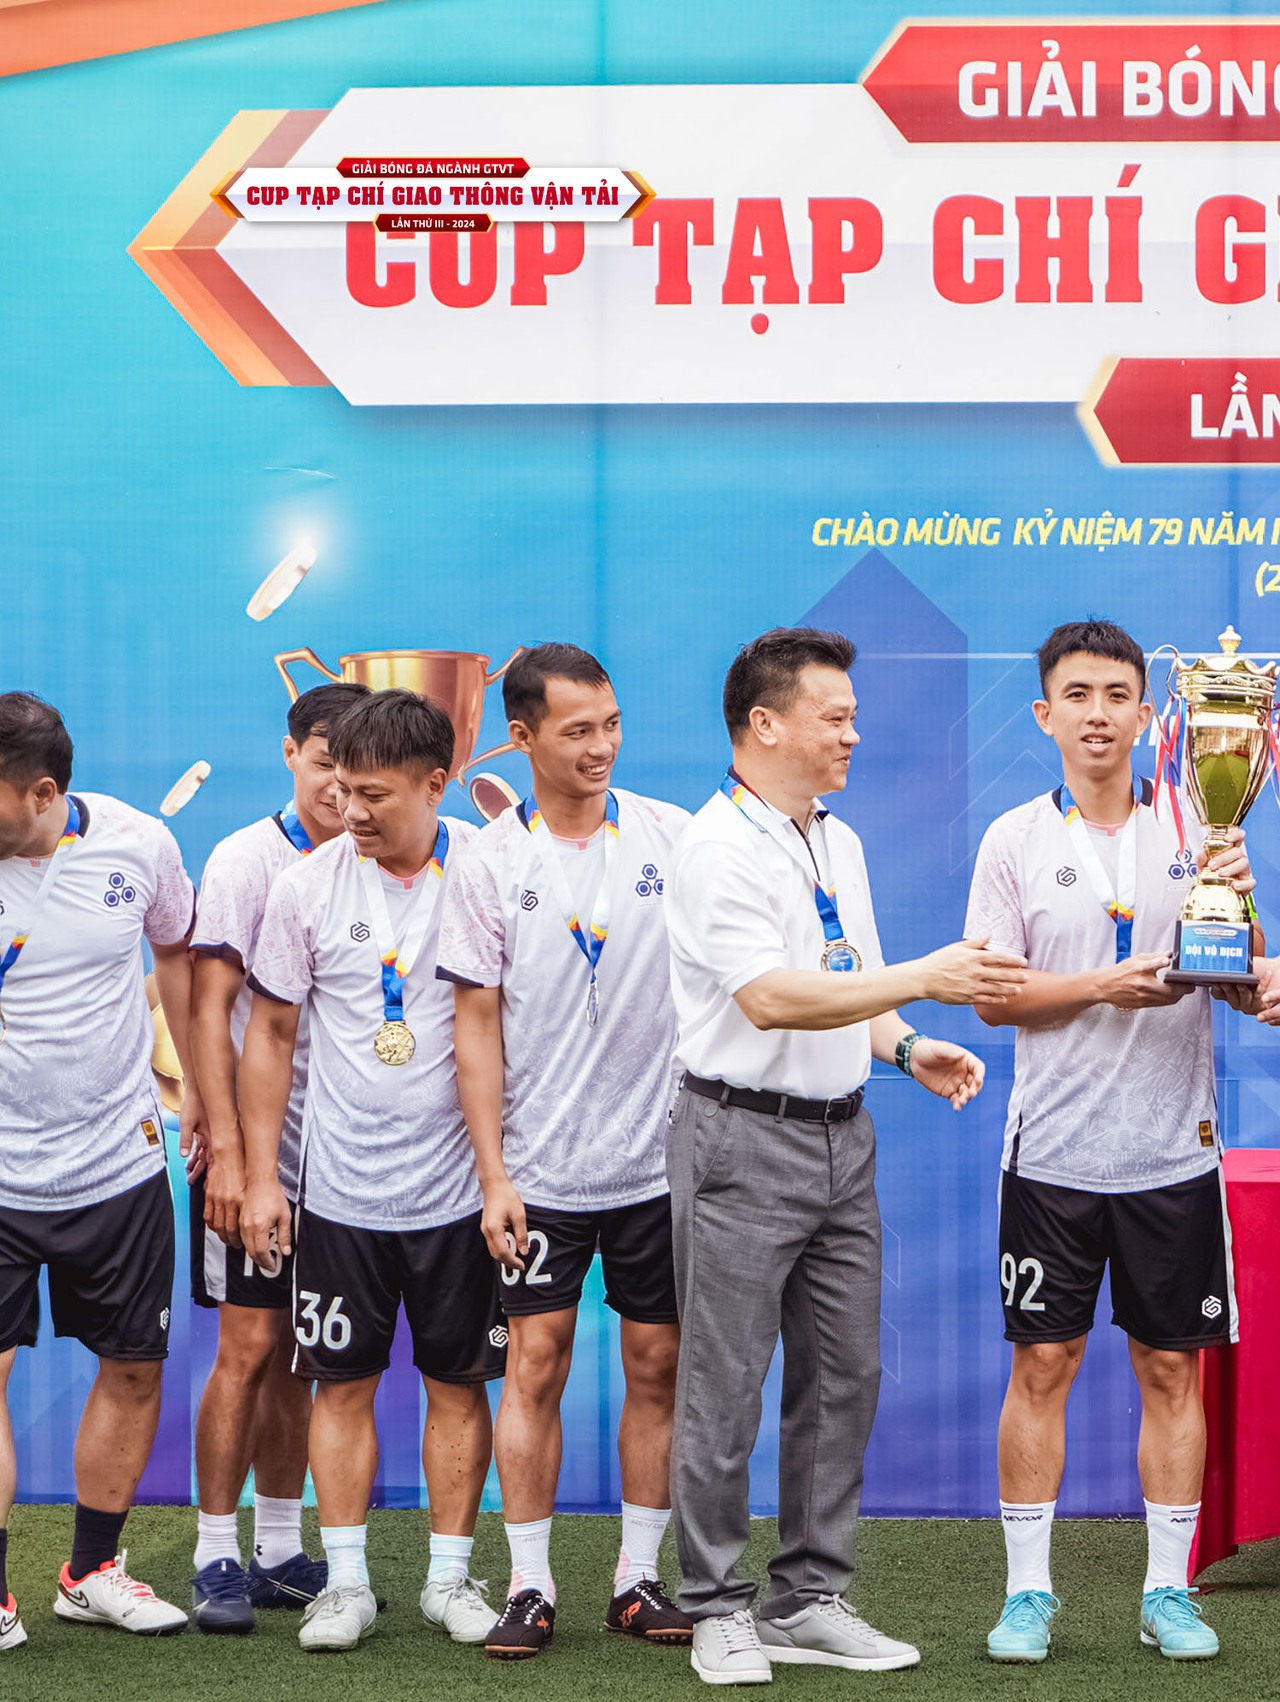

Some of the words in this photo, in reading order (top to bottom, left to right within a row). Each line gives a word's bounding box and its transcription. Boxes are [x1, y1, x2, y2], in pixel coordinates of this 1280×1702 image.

[958, 40, 1096, 118] GIẢI
[346, 220, 585, 308] CUP
[632, 196, 884, 335] TẠP
[932, 164, 1143, 305] CHÍ
[812, 511, 899, 546] CHÀO
[903, 511, 1002, 546] MỪNG
[1012, 508, 1058, 546] KỶ
[1059, 510, 1143, 552] NIỆM
[1148, 518, 1183, 546] 79
[1188, 511, 1266, 546] NĂM
[1000, 1252, 1046, 1312] 92
[297, 1290, 351, 1350] 36
